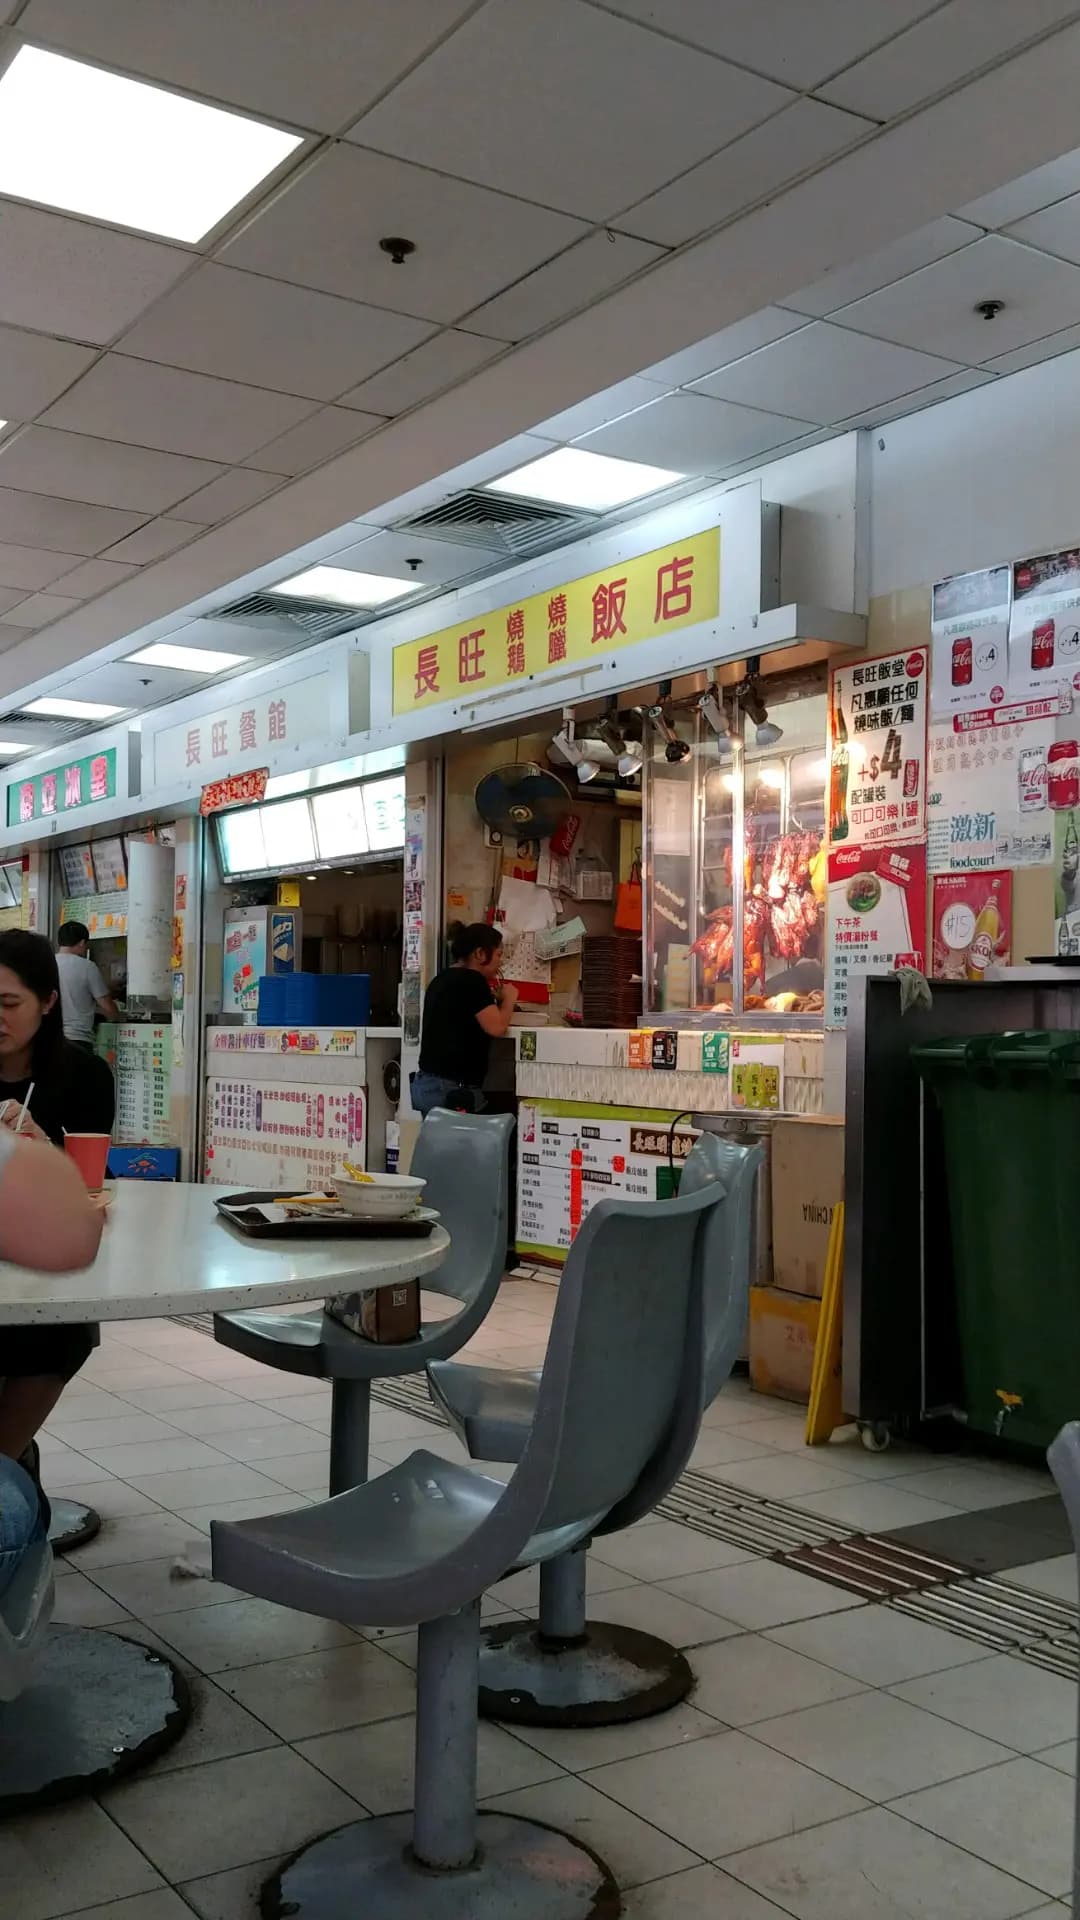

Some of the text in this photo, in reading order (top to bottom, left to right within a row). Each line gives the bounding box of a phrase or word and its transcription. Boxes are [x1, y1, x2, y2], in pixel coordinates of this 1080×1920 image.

[852, 658, 905, 686] 長旺飯堂
[186, 700, 287, 767] 長旺餐館
[836, 850, 862, 864] Coca-Cola
[950, 855, 995, 869] foodcourt
[835, 917, 861, 928] 下午茶
[802, 1203, 828, 1225] CHINA
